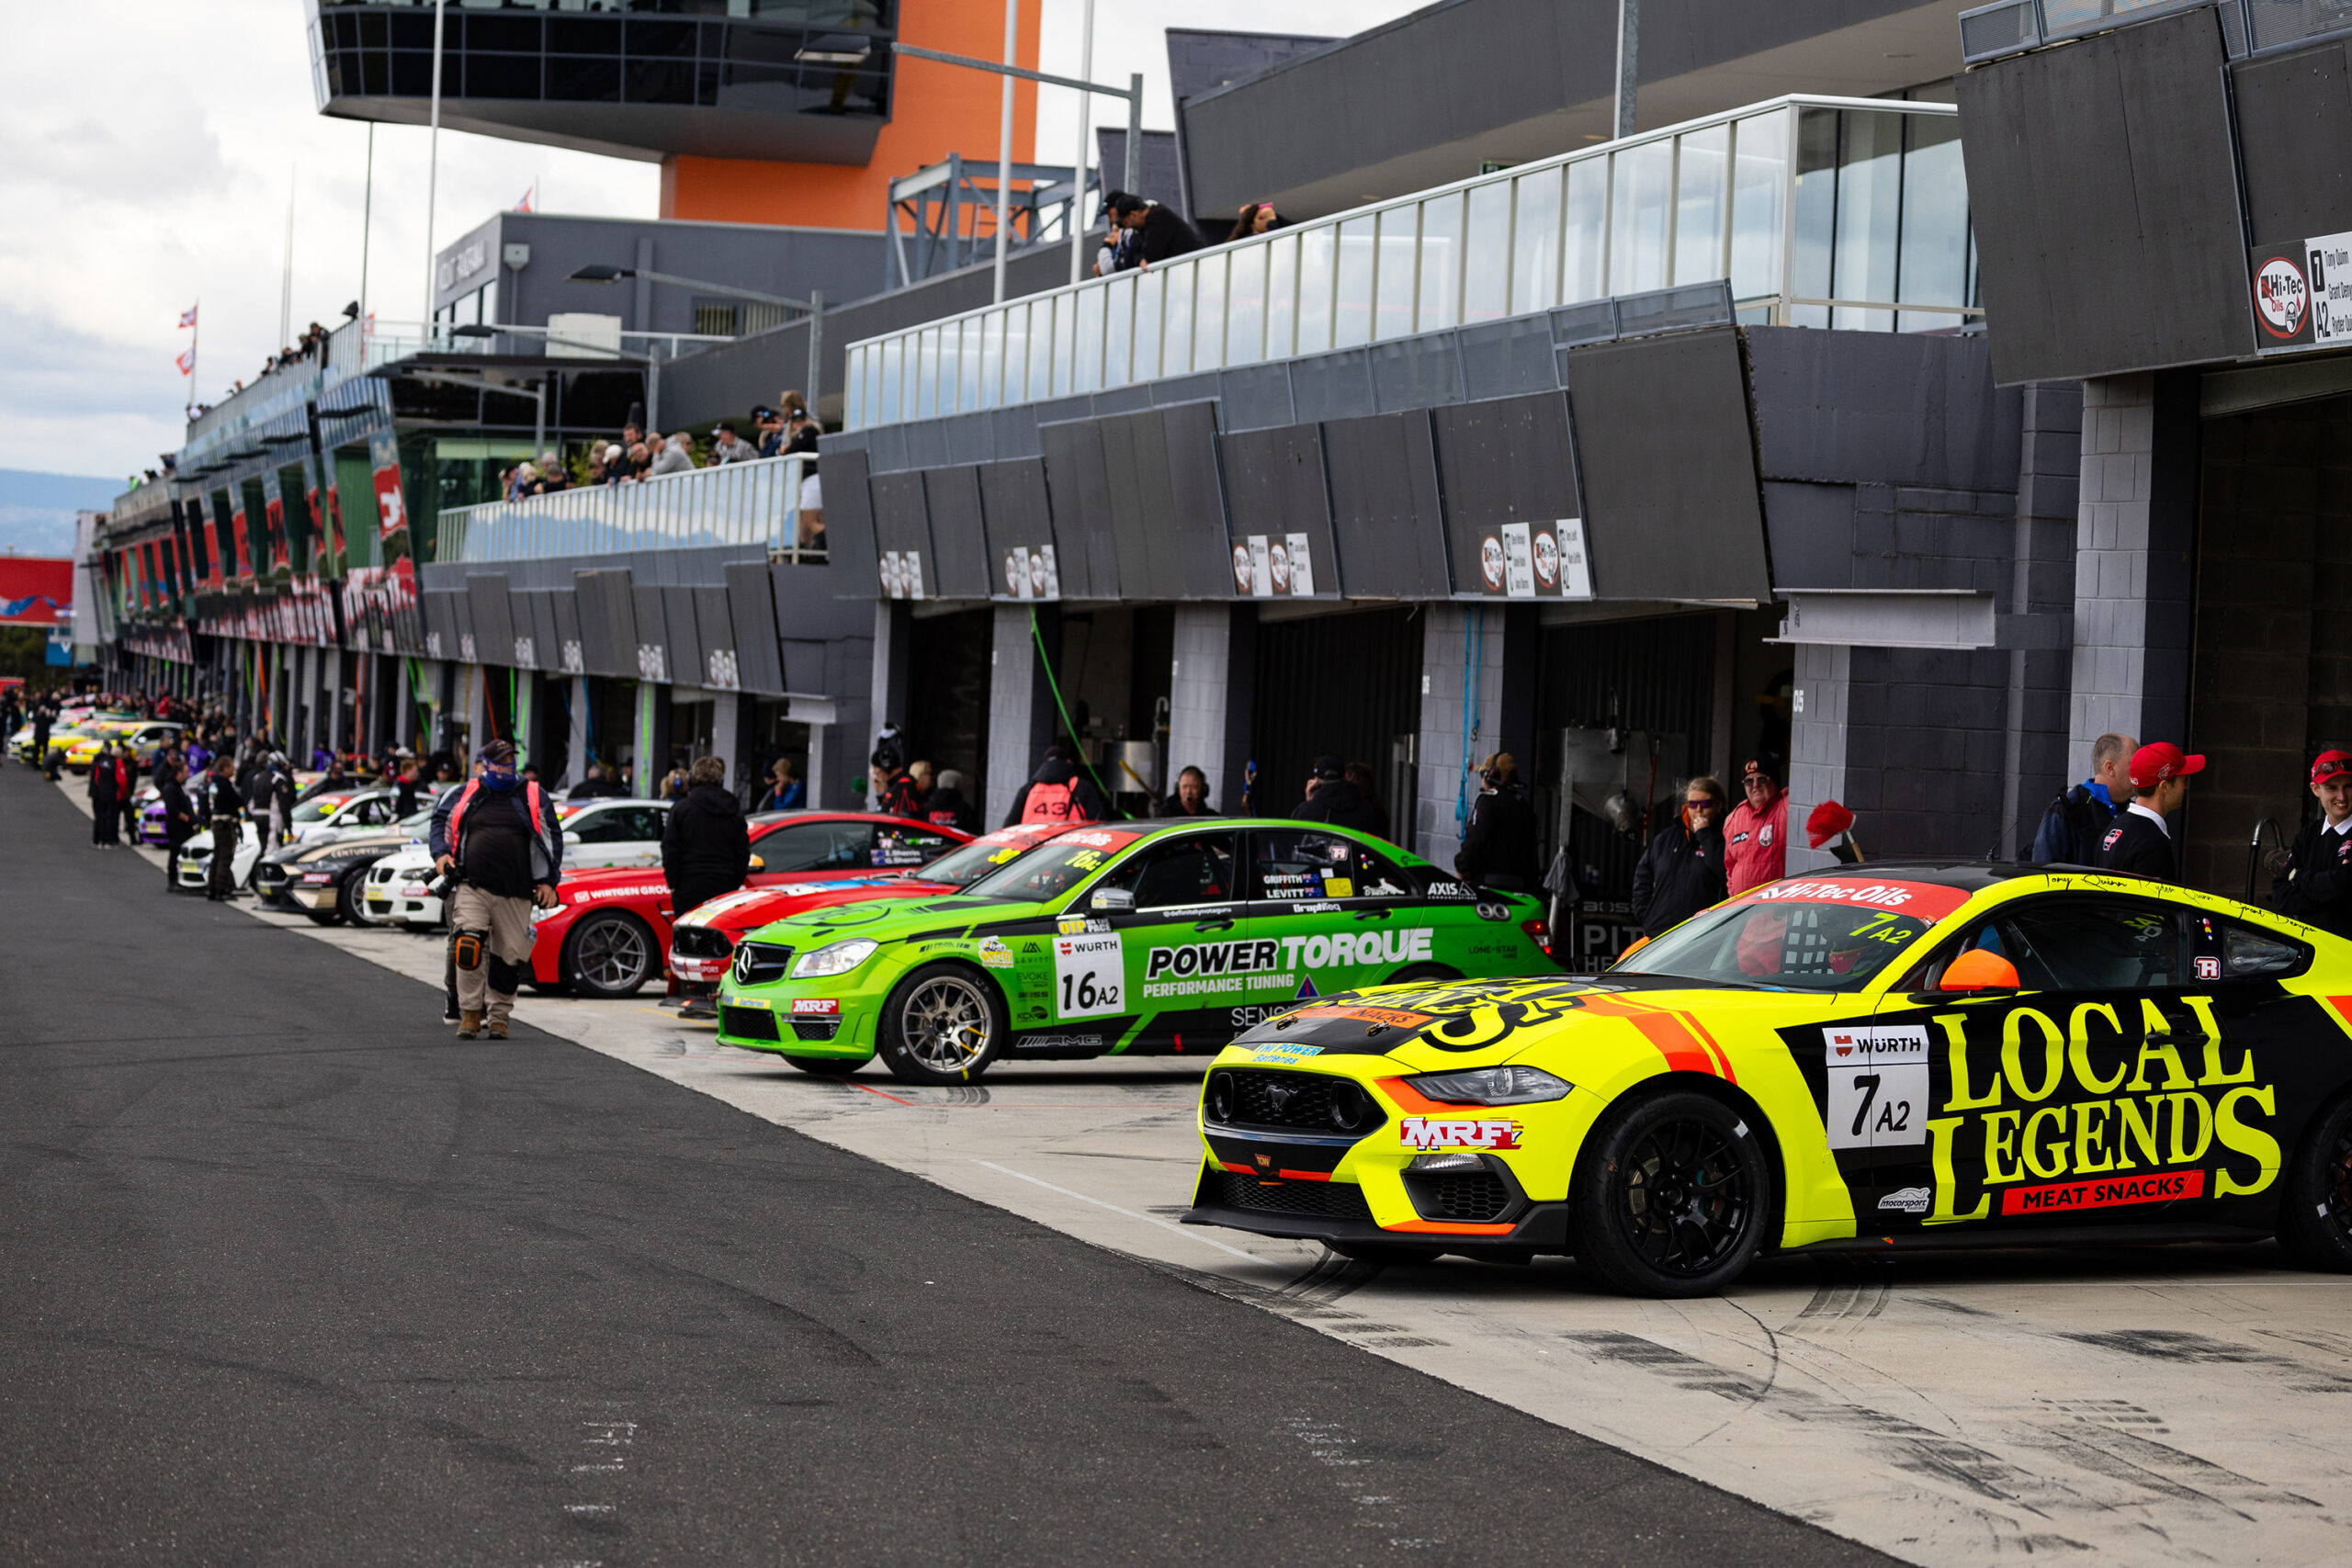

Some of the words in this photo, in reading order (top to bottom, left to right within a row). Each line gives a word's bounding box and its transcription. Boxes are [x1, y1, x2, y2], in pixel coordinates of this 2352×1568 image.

[2270, 274, 2303, 298] Hi-Tec
[2271, 299, 2284, 313] Oils
[2316, 301, 2331, 339] A2
[1793, 689, 1804, 713] 05
[1034, 802, 1068, 816] 43
[1065, 850, 1101, 868] 16
[1263, 874, 1303, 885] GRIFFITH
[591, 886, 639, 899] WIRTGEN
[1266, 887, 1305, 899] LEVITT
[1427, 882, 1458, 896] AXIS
[1781, 883, 1855, 899] Hi-Tec
[1850, 886, 1912, 906] Oils
[1058, 920, 1086, 934] OTP
[1849, 912, 1900, 937] 7
[1868, 926, 1912, 944] A2
[1075, 941, 1118, 953] WÜRTH
[1145, 938, 1280, 980] POWER
[1282, 928, 1434, 970] TORQUE
[1063, 971, 1096, 1011] 16
[1096, 986, 1119, 1007] A2
[1143, 976, 1243, 998] PERFORMANCE
[1245, 974, 1295, 991] TUNING
[793, 999, 836, 1012] MRF
[1276, 1043, 1324, 1057] POWER
[1857, 1037, 1921, 1053] WÜRTH
[1252, 1055, 1298, 1065] Batteries
[1933, 997, 2255, 1112] LOCAL
[1851, 1074, 1881, 1136] 7
[1875, 1100, 1911, 1133] A2
[1401, 1120, 1512, 1146] MRF
[1256, 1156, 1270, 1168] TOW
[1922, 1085, 2282, 1225] LEGENDS
[2022, 1186, 2088, 1210] MEAT
[2094, 1177, 2186, 1201] SNACKS
[1881, 1200, 1927, 1211] motorsport
